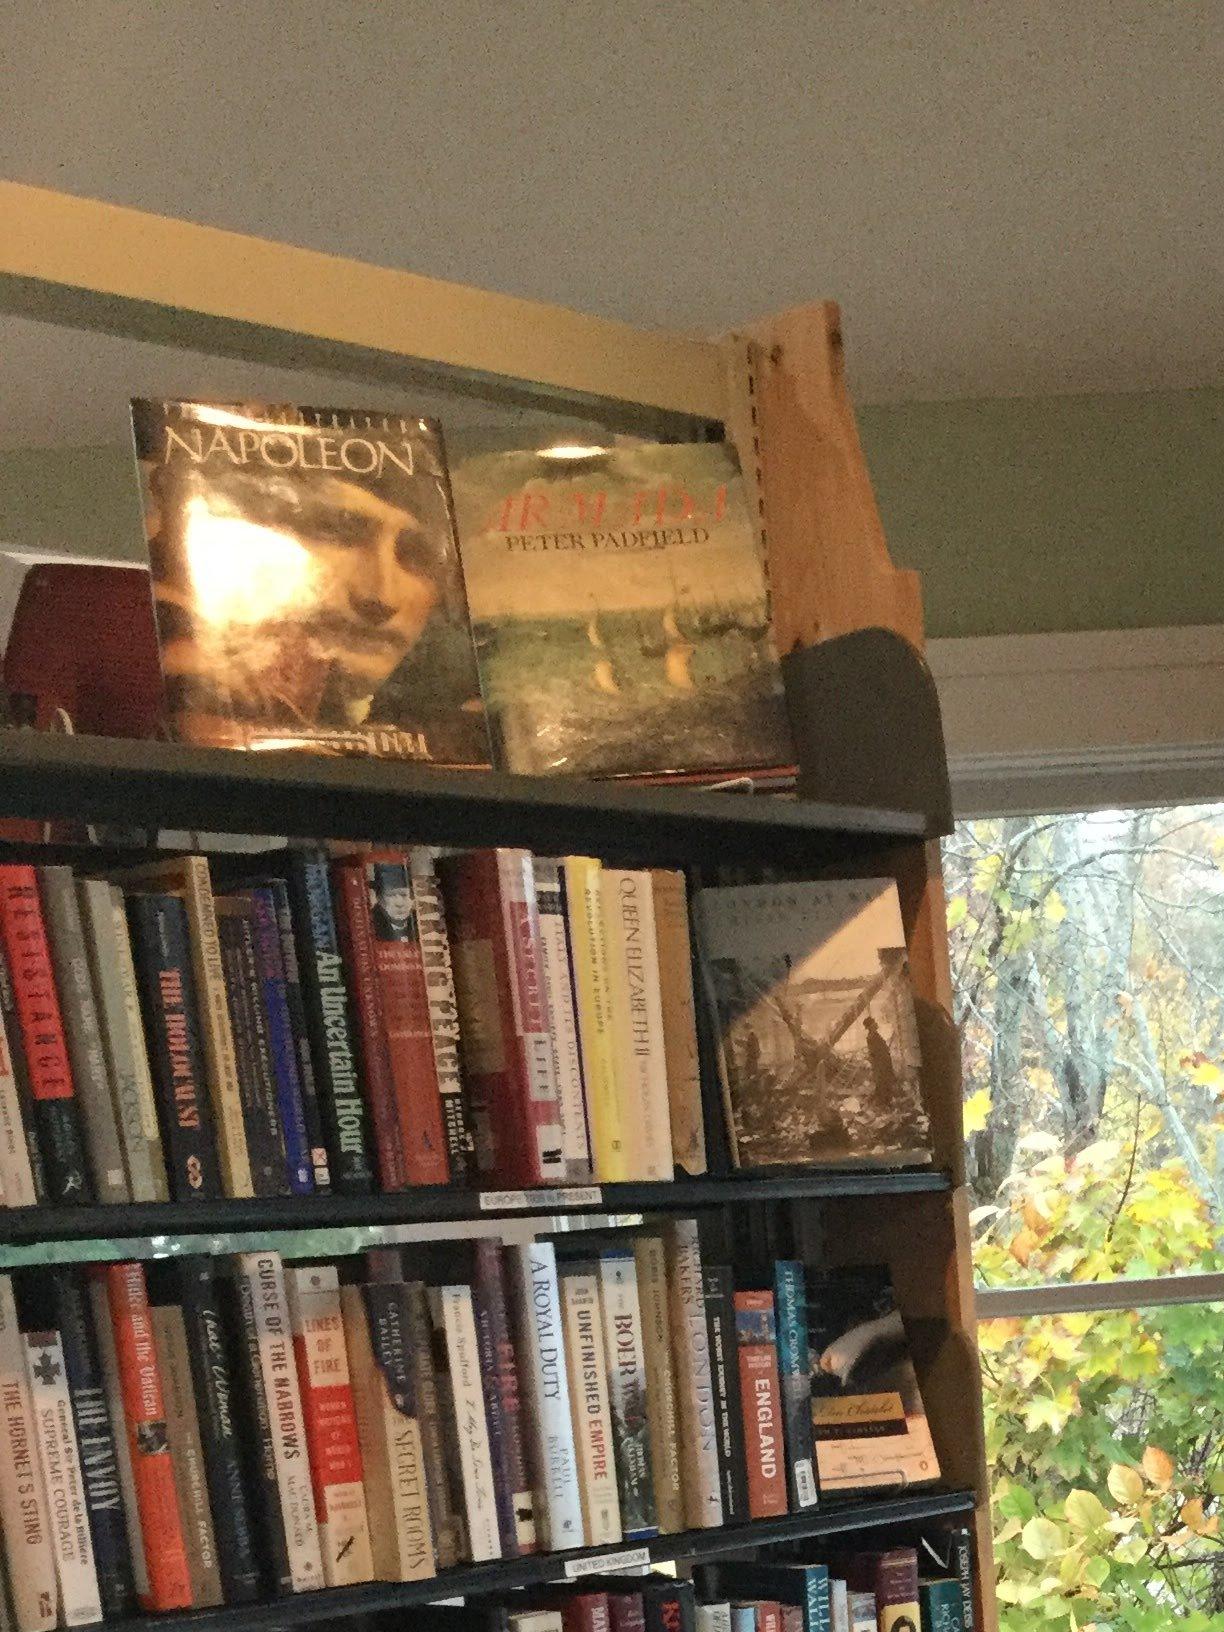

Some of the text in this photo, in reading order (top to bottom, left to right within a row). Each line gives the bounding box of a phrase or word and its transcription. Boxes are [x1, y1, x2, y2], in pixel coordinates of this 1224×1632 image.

[164, 427, 415, 479] NAPOLEON
[504, 527, 711, 553] PETER PADFIELD
[618, 876, 641, 943] QUEEN
[314, 950, 344, 982] An
[413, 873, 460, 1084] MAKING PEACE
[522, 935, 544, 1026] SECRET
[584, 888, 604, 1035] REVOLUTION IN EUROPE
[624, 946, 650, 1044] ELIZABETH
[319, 986, 358, 1094] Uncertain
[334, 1096, 366, 1156] Hour
[444, 1099, 459, 1154] MITCHELL
[129, 1313, 149, 1339] and
[304, 1315, 341, 1334] LINES
[783, 1270, 796, 1326] THOMAS
[134, 1340, 152, 1363] the
[256, 1258, 300, 1460] CURSE OF THE NARROWS
[378, 1317, 395, 1368] BAILEY
[386, 1302, 404, 1384] CATHERINE
[530, 1258, 561, 1401] A ROYAL DUTY
[611, 1313, 639, 1375] BOER
[138, 1365, 161, 1415] Vatican
[313, 1358, 341, 1374] FIRE
[577, 1309, 606, 1480] UNFINISHED EMPIRE
[690, 1315, 715, 1452] LONDON
[662, 1369, 679, 1490] CHURCHILL FACTOR
[722, 1428, 732, 1457] WORLD
[753, 1378, 778, 1478] ENGLAND
[2, 1381, 42, 1545] THE STING
[37, 1407, 78, 1561] SUPREME COURAGE
[390, 1429, 429, 1570] SECRET ROOMS
[194, 1520, 214, 1568] FACTOR
[957, 1545, 969, 1579] JOSEPH
[960, 1582, 971, 1597] JAY
